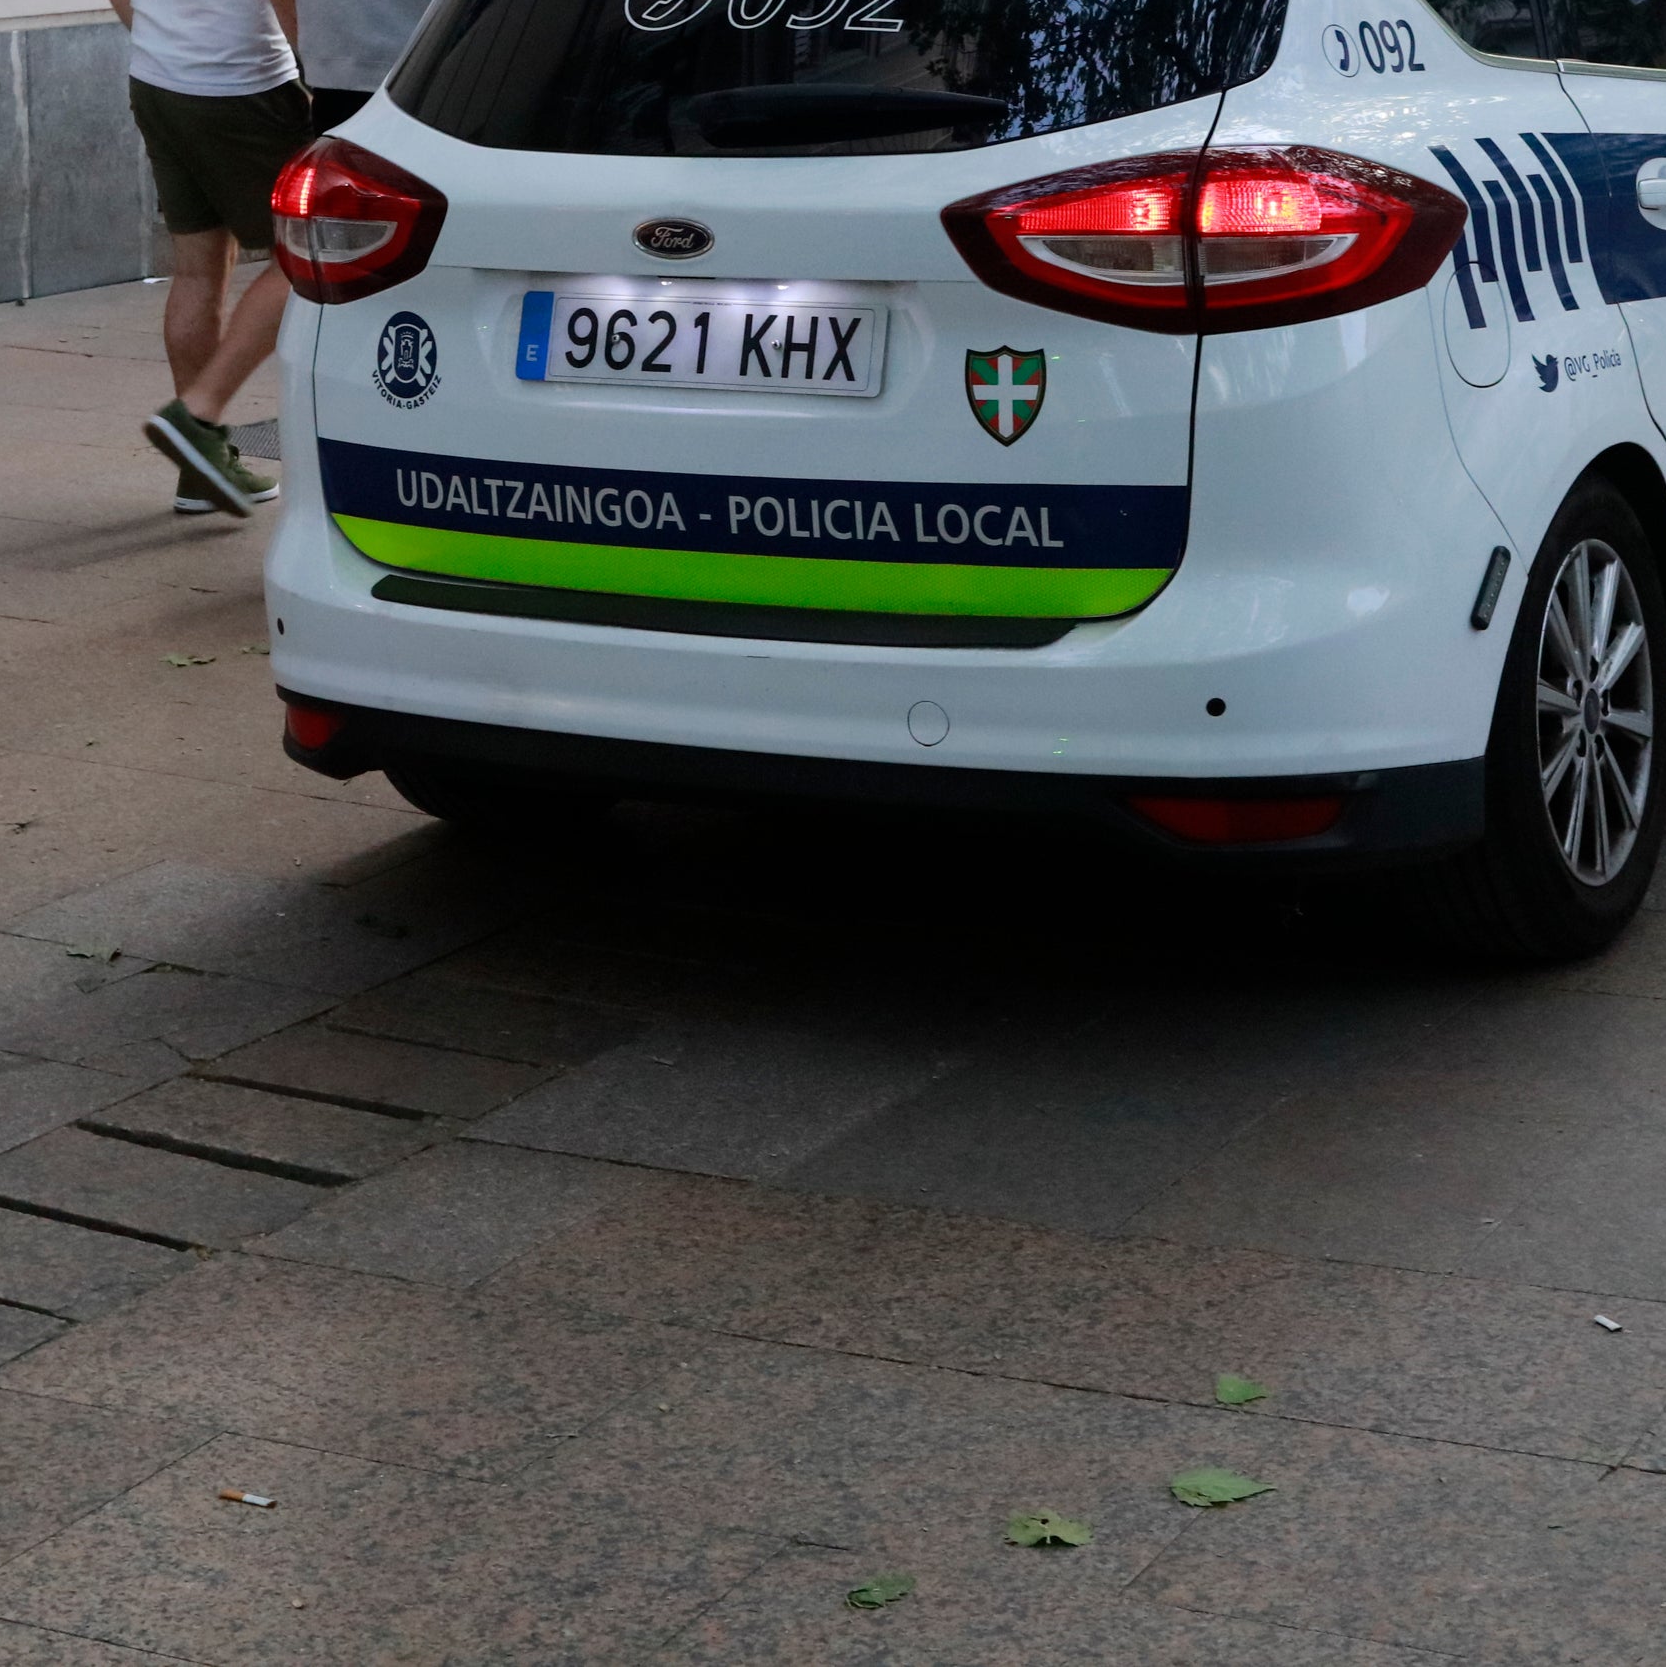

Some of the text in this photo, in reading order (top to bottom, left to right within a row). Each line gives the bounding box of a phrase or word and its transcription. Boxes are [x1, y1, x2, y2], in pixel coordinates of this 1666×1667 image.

[1358, 19, 1426, 74] 092
[650, 226, 695, 250] Ford
[525, 344, 538, 362] E
[565, 307, 862, 382] 9621 KHX
[371, 369, 443, 410] VITORIA-GASTEIZ
[396, 468, 1065, 548] UDALTZAINGOA - POLICIA LOCAL
